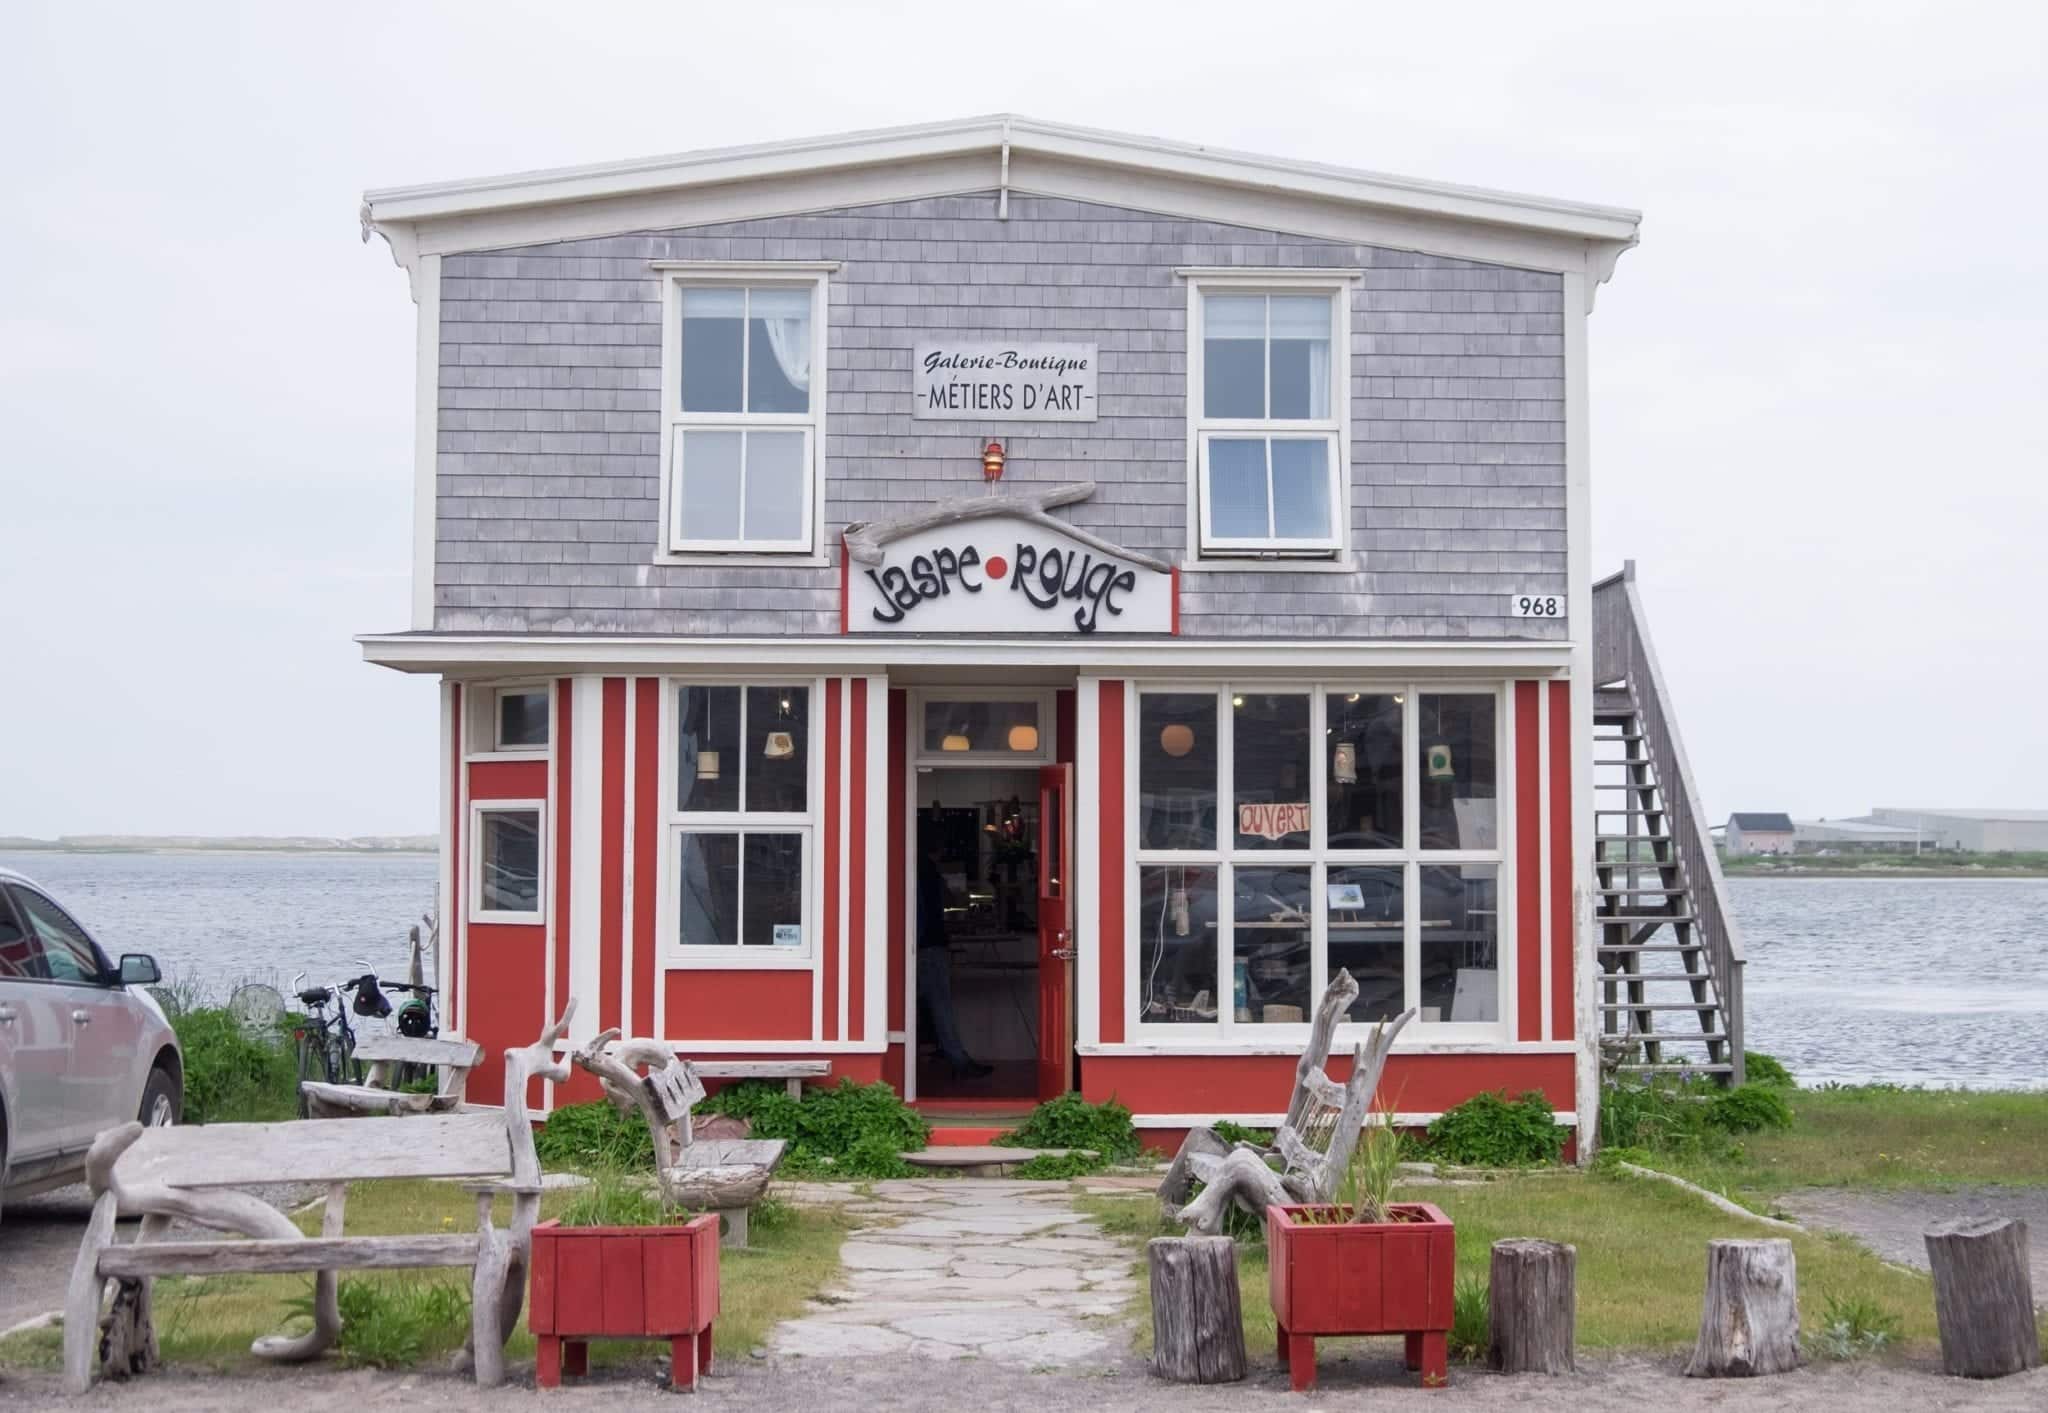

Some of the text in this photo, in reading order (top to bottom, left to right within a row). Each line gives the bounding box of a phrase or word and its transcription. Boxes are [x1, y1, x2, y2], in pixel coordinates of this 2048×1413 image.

[924, 350, 1088, 376] Galerie-Boutique
[1010, 543, 1136, 633] Rouge
[1519, 597, 1557, 616] 968
